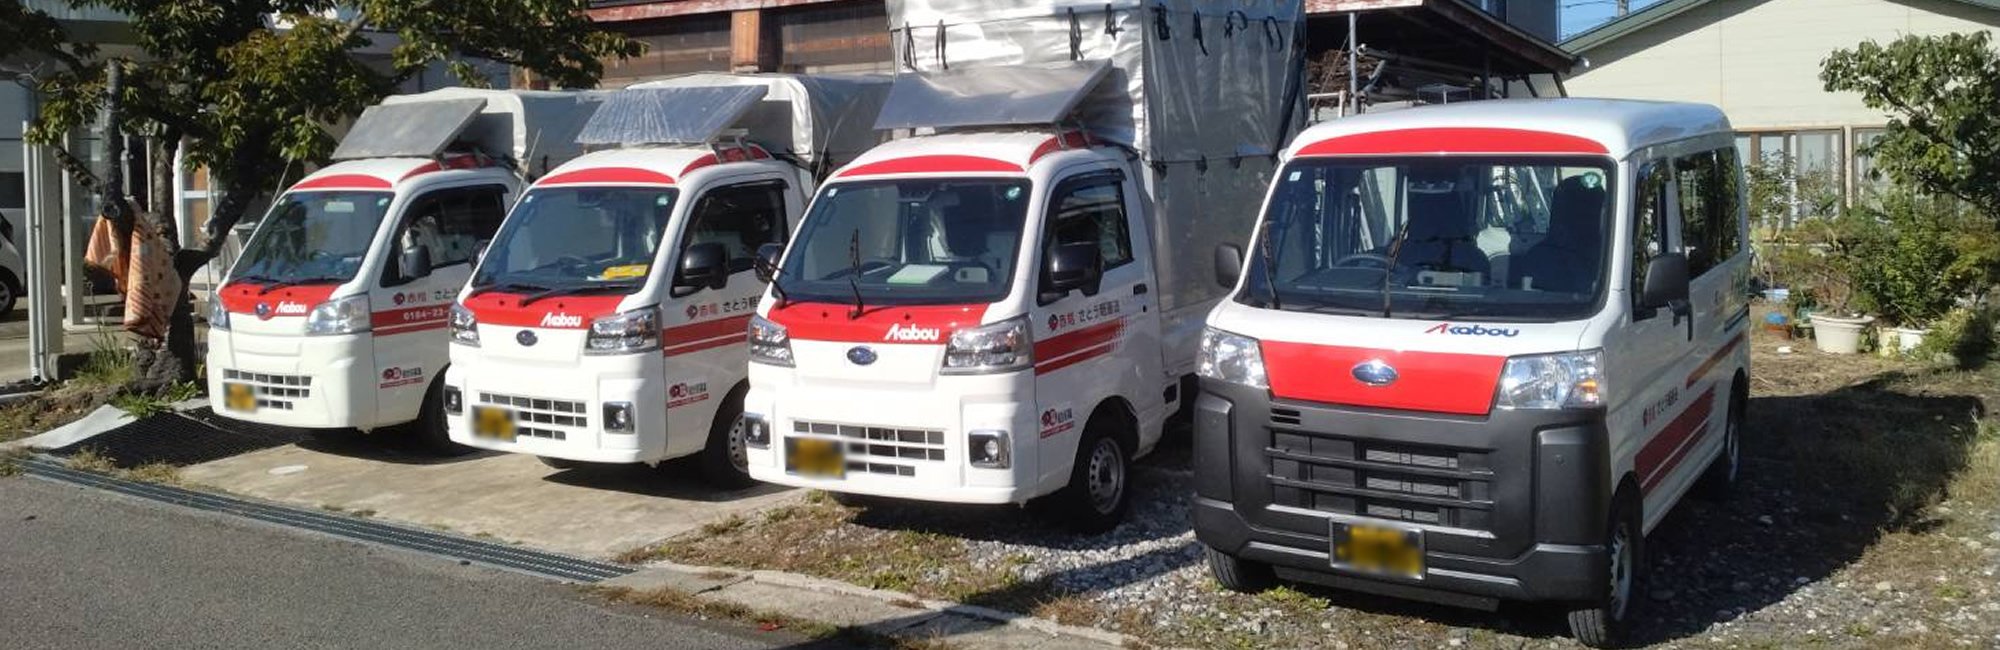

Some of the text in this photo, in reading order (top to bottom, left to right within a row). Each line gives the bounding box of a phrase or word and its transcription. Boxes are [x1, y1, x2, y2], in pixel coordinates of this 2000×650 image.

[540, 312, 582, 328] Akabou
[884, 323, 940, 341] Akabou
[1424, 322, 1520, 338] Akabou
